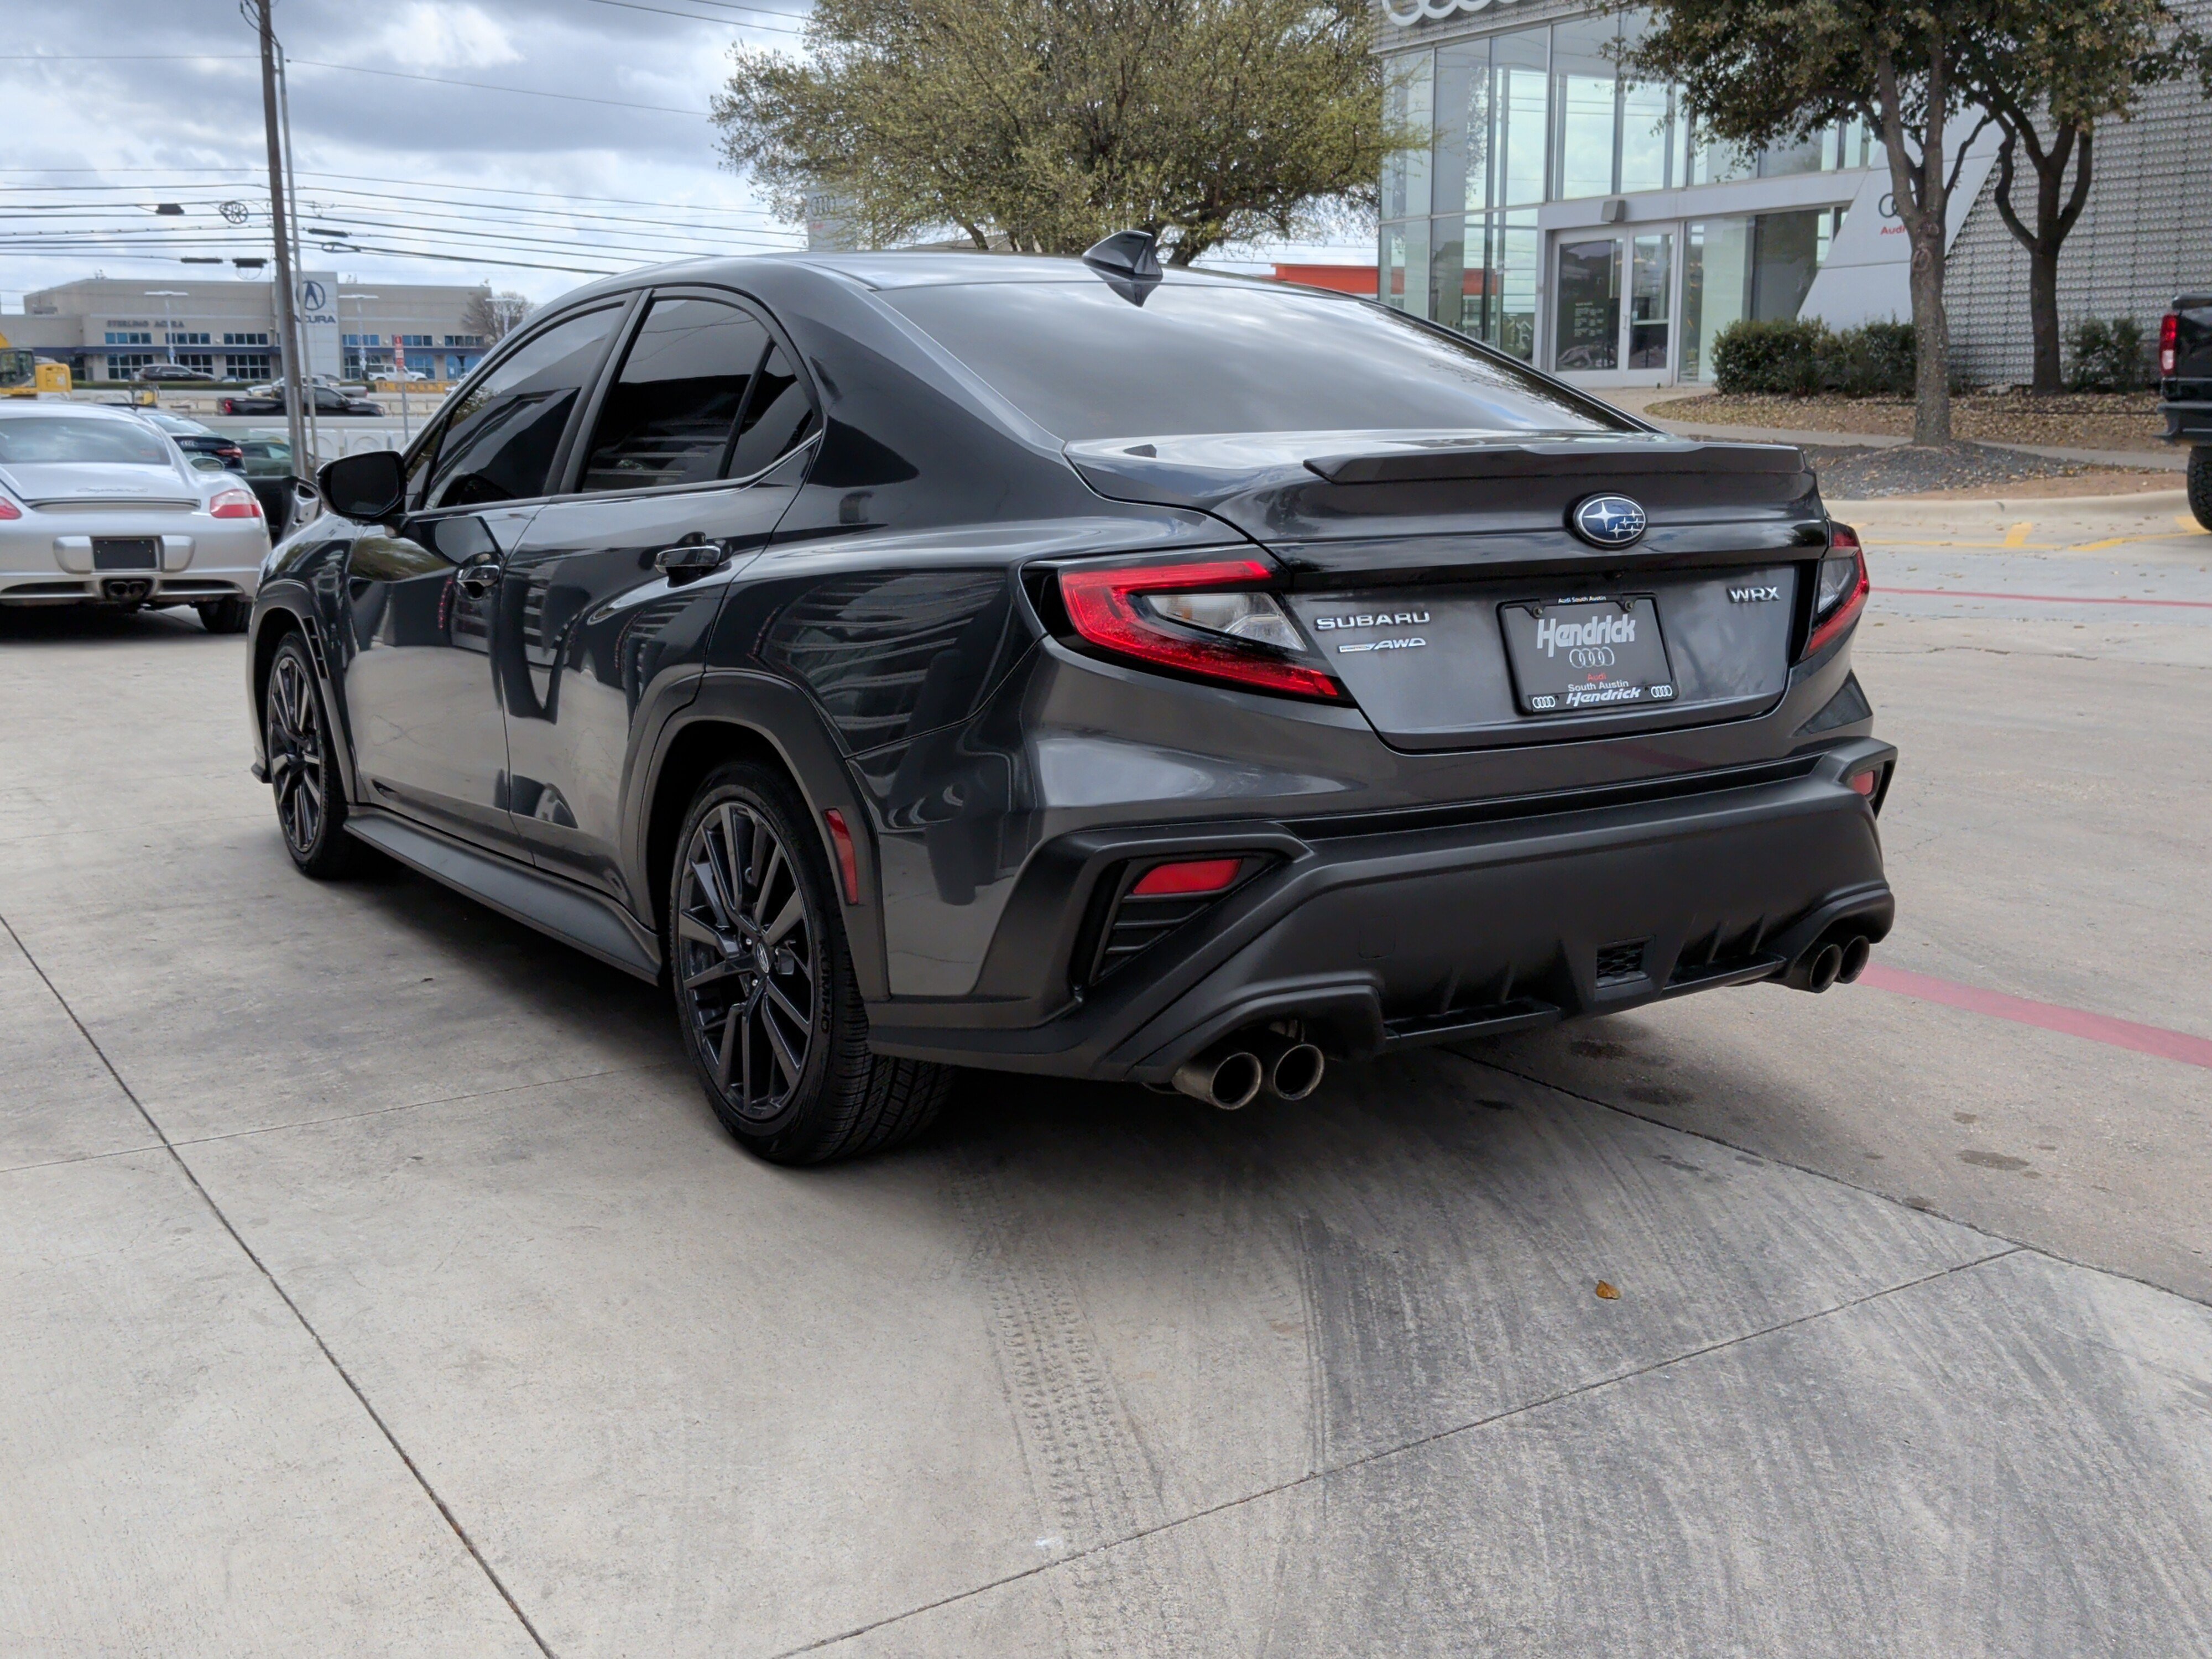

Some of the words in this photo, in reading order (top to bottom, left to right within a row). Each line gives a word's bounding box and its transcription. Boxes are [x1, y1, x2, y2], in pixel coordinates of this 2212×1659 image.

[294, 315, 336, 324] URA
[1728, 586, 1781, 603] WRX
[1316, 611, 1431, 631] SUBARU
[1374, 637, 1427, 650] AWD
[1536, 614, 1636, 658] Hendrick
[1587, 673, 1606, 681] Audi
[1567, 683, 1597, 692] South
[1598, 679, 1629, 690] Austin
[1566, 687, 1641, 707] Hendrick
